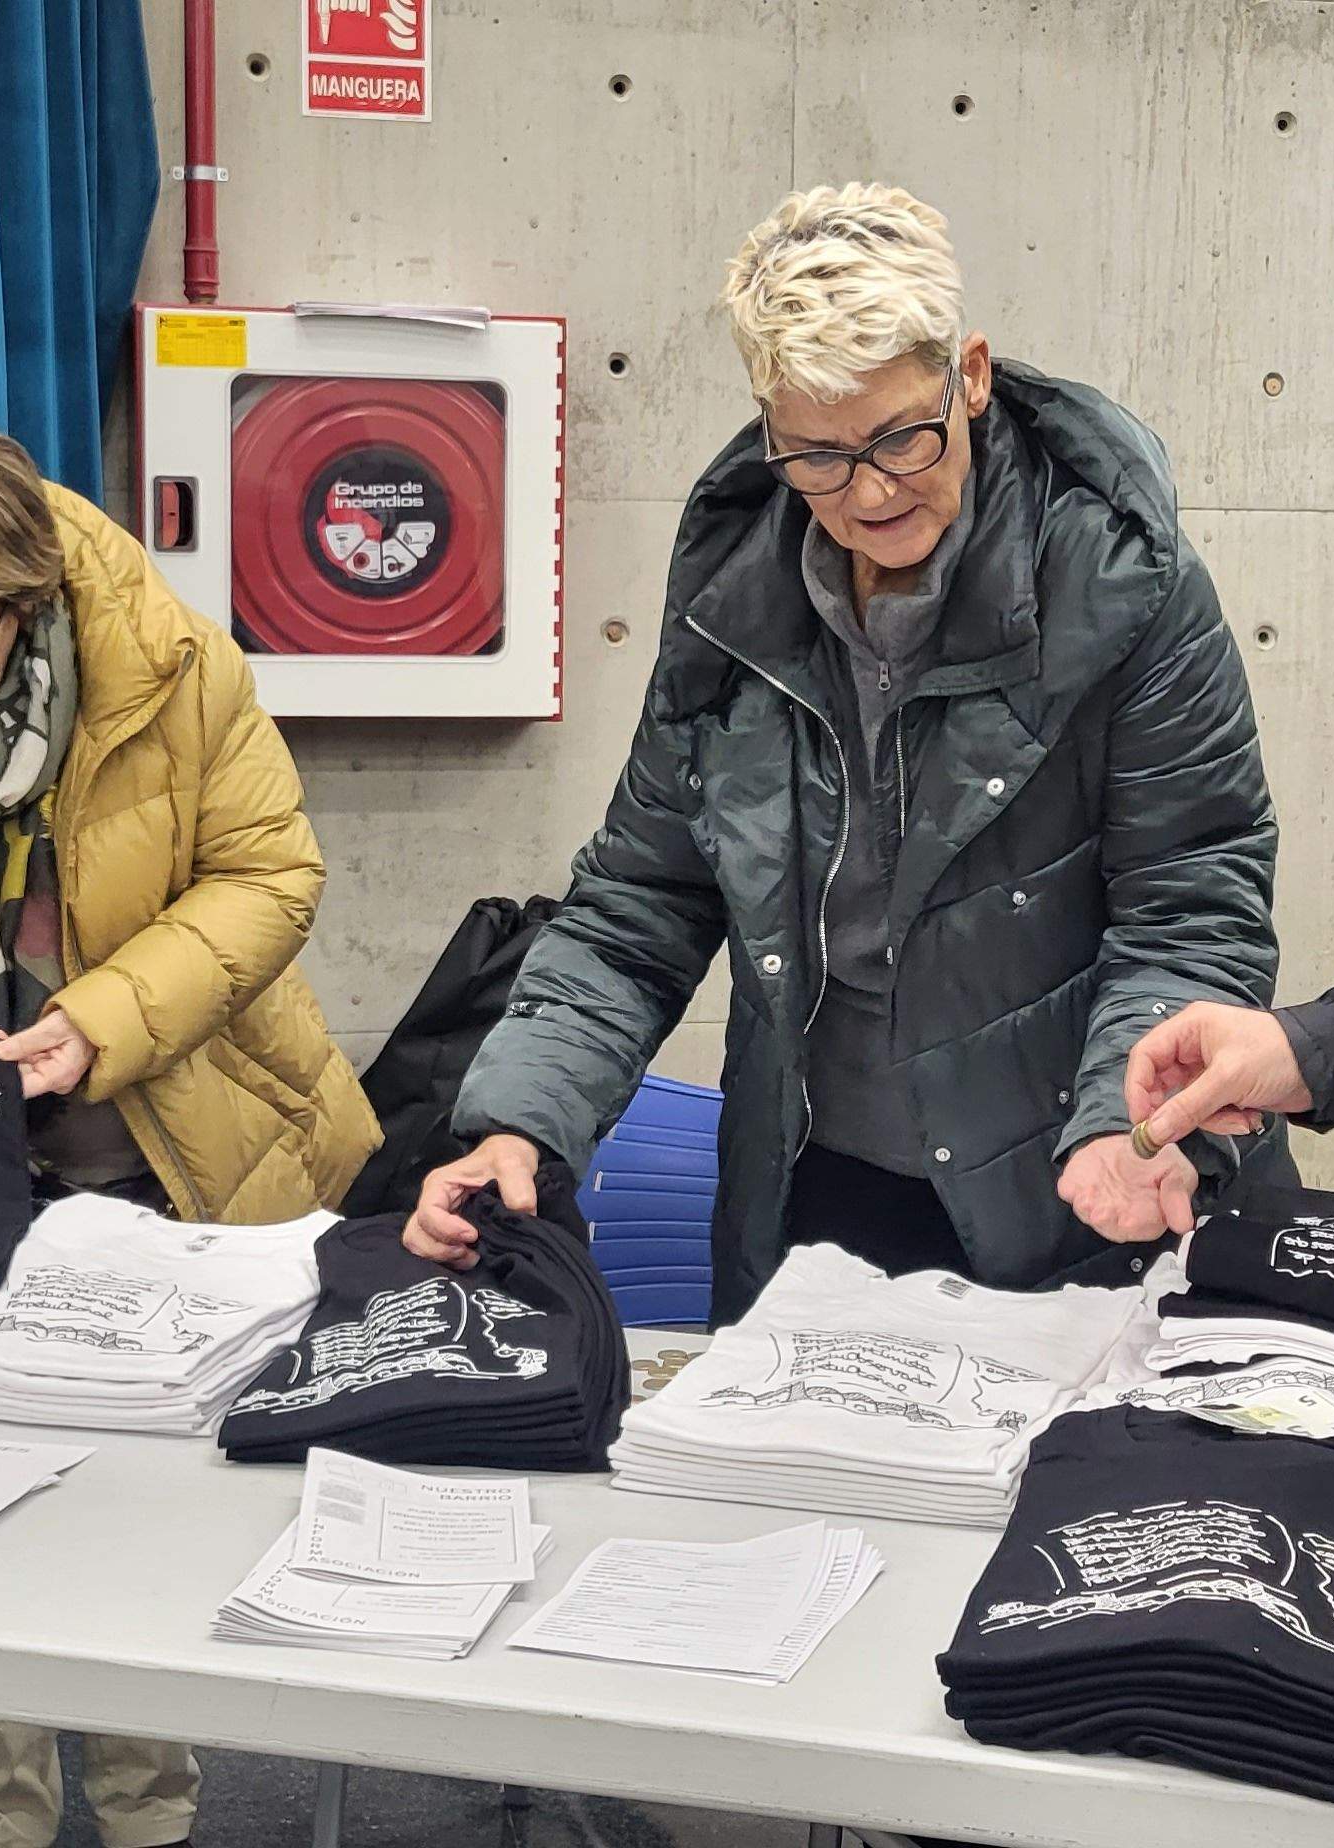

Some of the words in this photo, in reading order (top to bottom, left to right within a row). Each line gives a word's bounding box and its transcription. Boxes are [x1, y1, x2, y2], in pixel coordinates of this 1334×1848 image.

[311, 73, 421, 101] MANGUERA
[334, 482, 397, 497] Grupo
[400, 480, 423, 494] de
[334, 495, 425, 509] Incendios
[421, 1484, 512, 1495] NUESTRO
